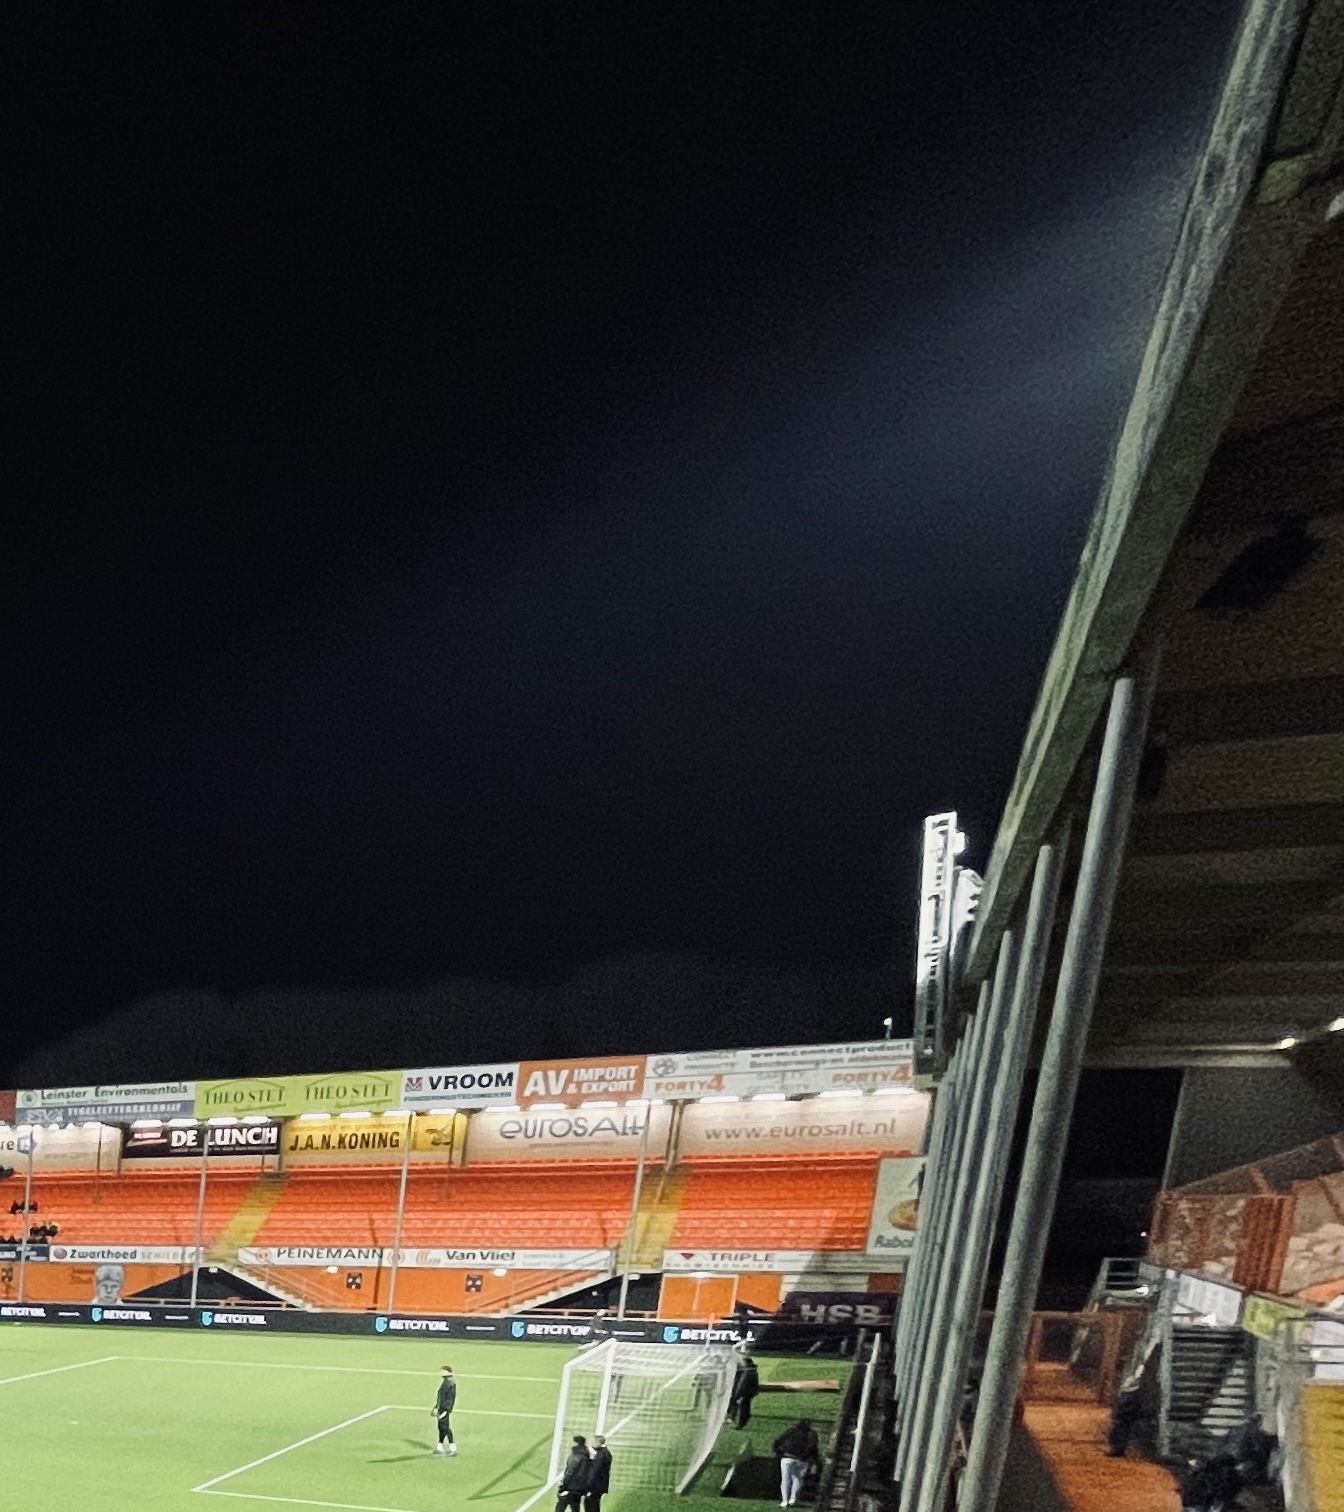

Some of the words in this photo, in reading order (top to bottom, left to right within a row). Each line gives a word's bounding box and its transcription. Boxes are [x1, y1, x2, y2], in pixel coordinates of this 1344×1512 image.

[428, 1071, 514, 1091] VROOM
[523, 1069, 567, 1096] AV
[572, 1064, 640, 1082] IMPORT
[580, 1078, 636, 1095] EXPORT
[40, 1090, 87, 1100] Leinster
[94, 1082, 188, 1098] Environmentals
[170, 1129, 199, 1147] DE
[208, 1126, 279, 1146] LUNCH
[704, 1118, 897, 1141] www.eurosalt.nl
[69, 1248, 138, 1260] Zwarthoed
[276, 1246, 384, 1260] PEINEMANN
[710, 1252, 776, 1262] TRIPLE
